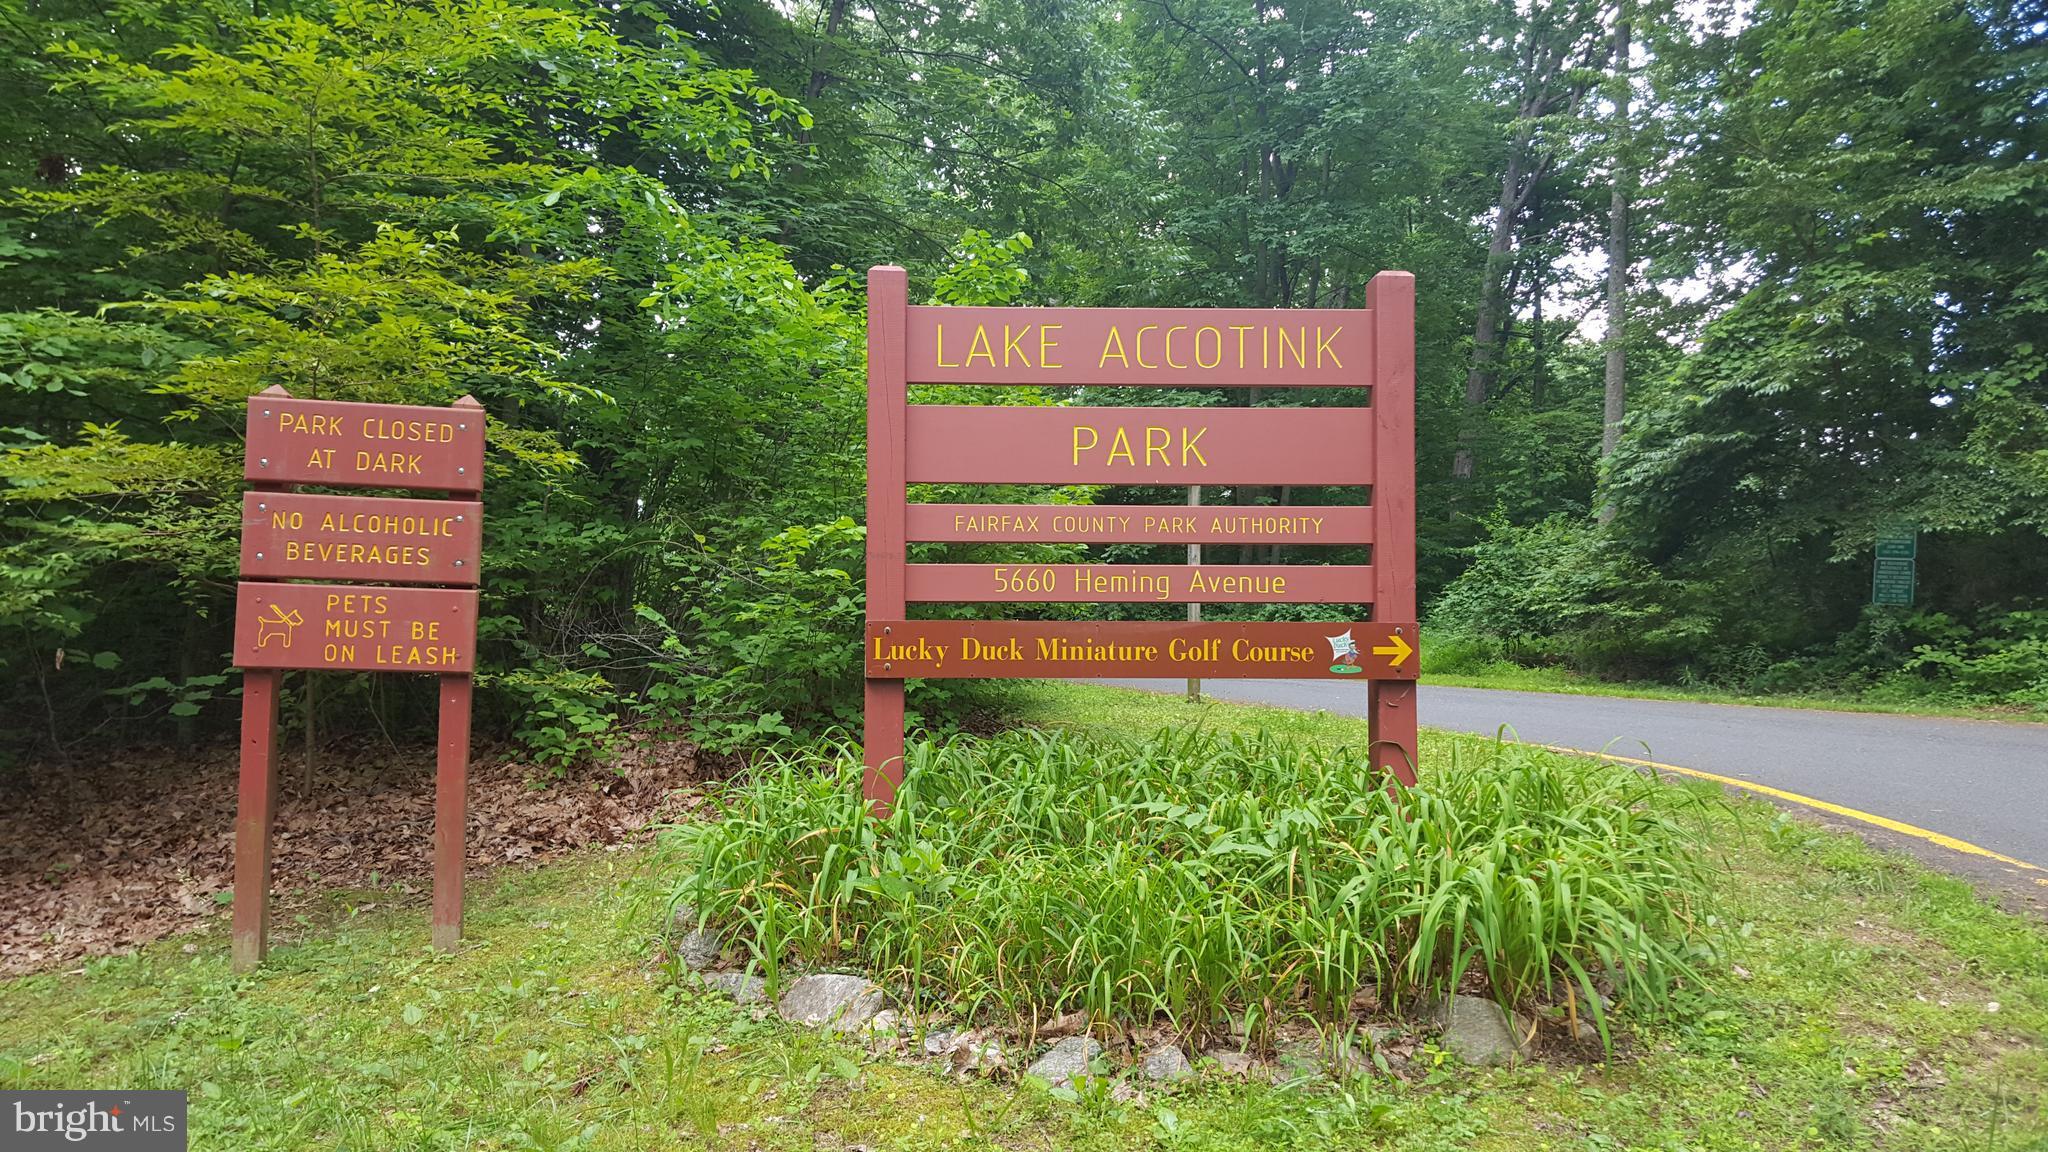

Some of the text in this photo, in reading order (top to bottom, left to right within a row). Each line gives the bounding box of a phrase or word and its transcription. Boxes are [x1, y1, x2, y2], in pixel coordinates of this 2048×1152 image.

[937, 323, 1344, 369] LAKE ACCOTINK
[279, 412, 454, 443] PARK CLOSED
[1073, 425, 1208, 467] PARK
[307, 449, 422, 474] AT DARK
[272, 511, 454, 537] NO ALCOHOLIC
[955, 515, 1324, 534] FAIRFAX COUNTY PARK AUTHORITY
[286, 541, 431, 566] BEVERAGES
[994, 568, 1286, 600] 5660 Heming Avenue
[326, 594, 388, 614] PETS
[325, 620, 440, 641] MUST BE
[324, 644, 456, 665] ON LEASH
[872, 637, 1315, 668] Lucky Duck Miniature Golf Course
